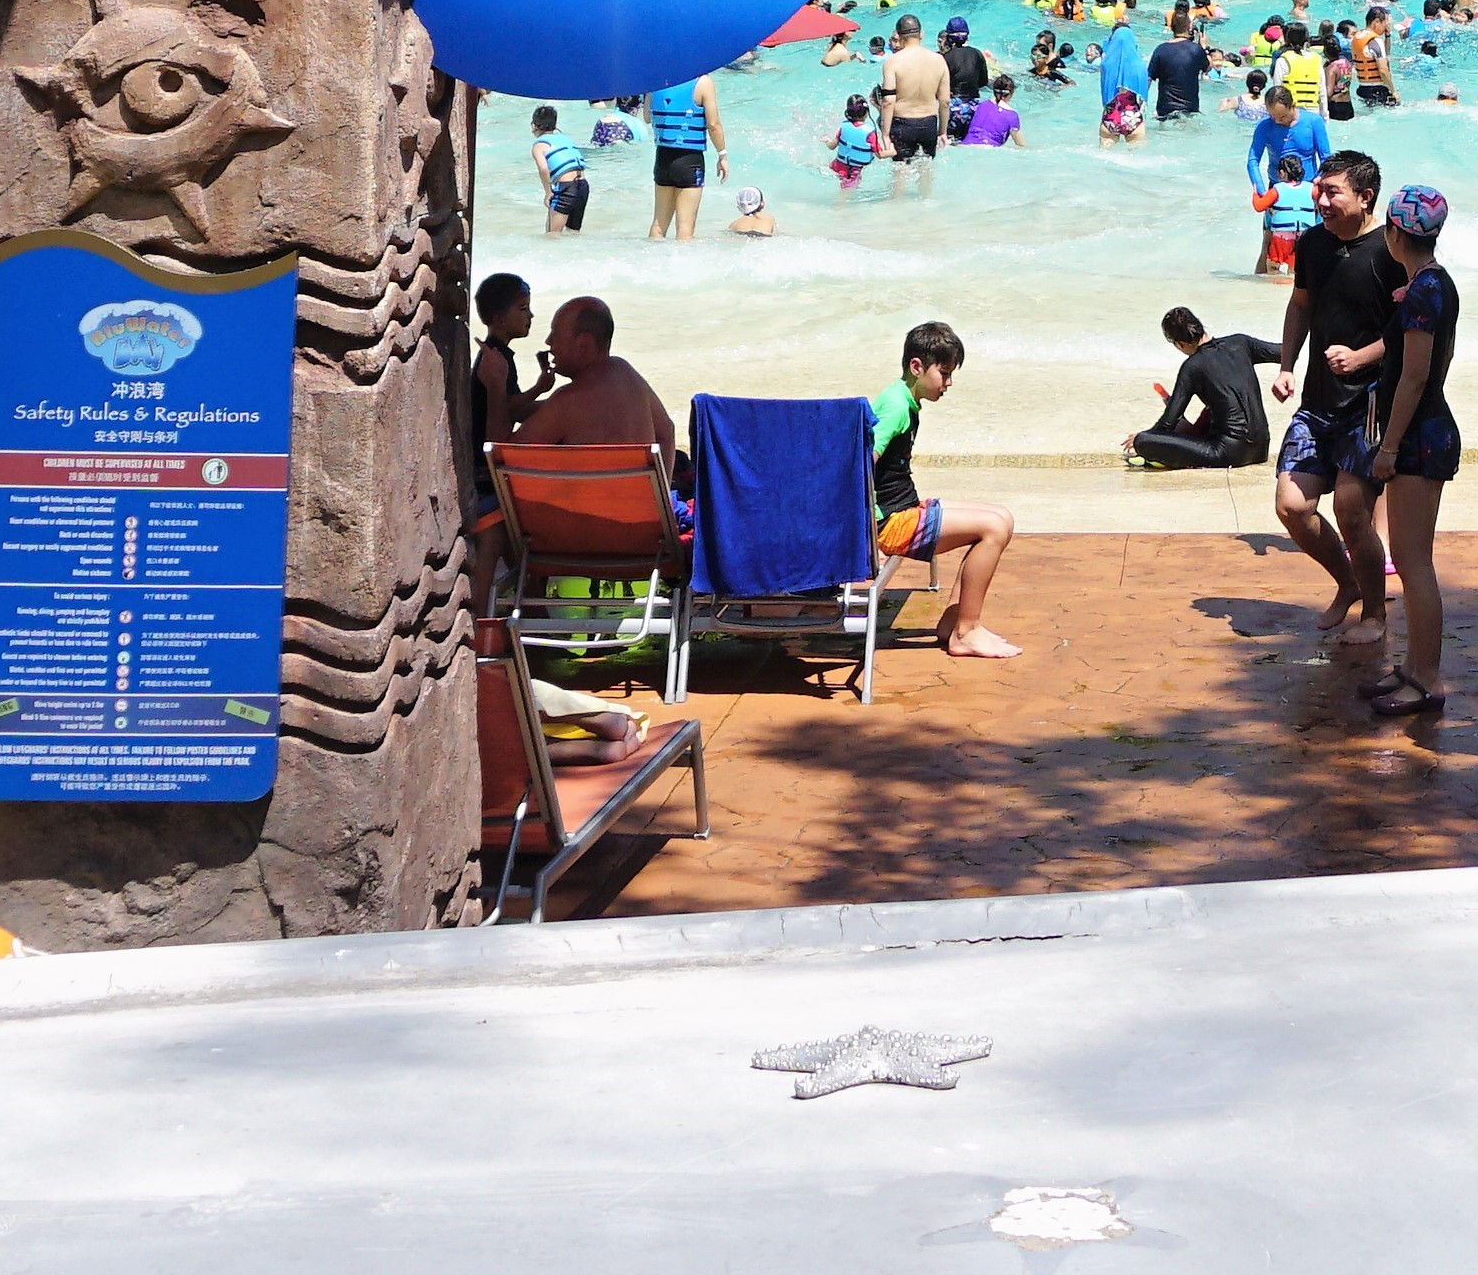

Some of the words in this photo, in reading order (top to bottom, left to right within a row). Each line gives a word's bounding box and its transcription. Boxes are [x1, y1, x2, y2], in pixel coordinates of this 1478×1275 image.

[110, 381, 165, 400] 冲浪湾
[13, 400, 74, 427] Safety
[79, 402, 129, 422] Rules
[133, 407, 149, 423] &
[154, 402, 261, 429] Regulations
